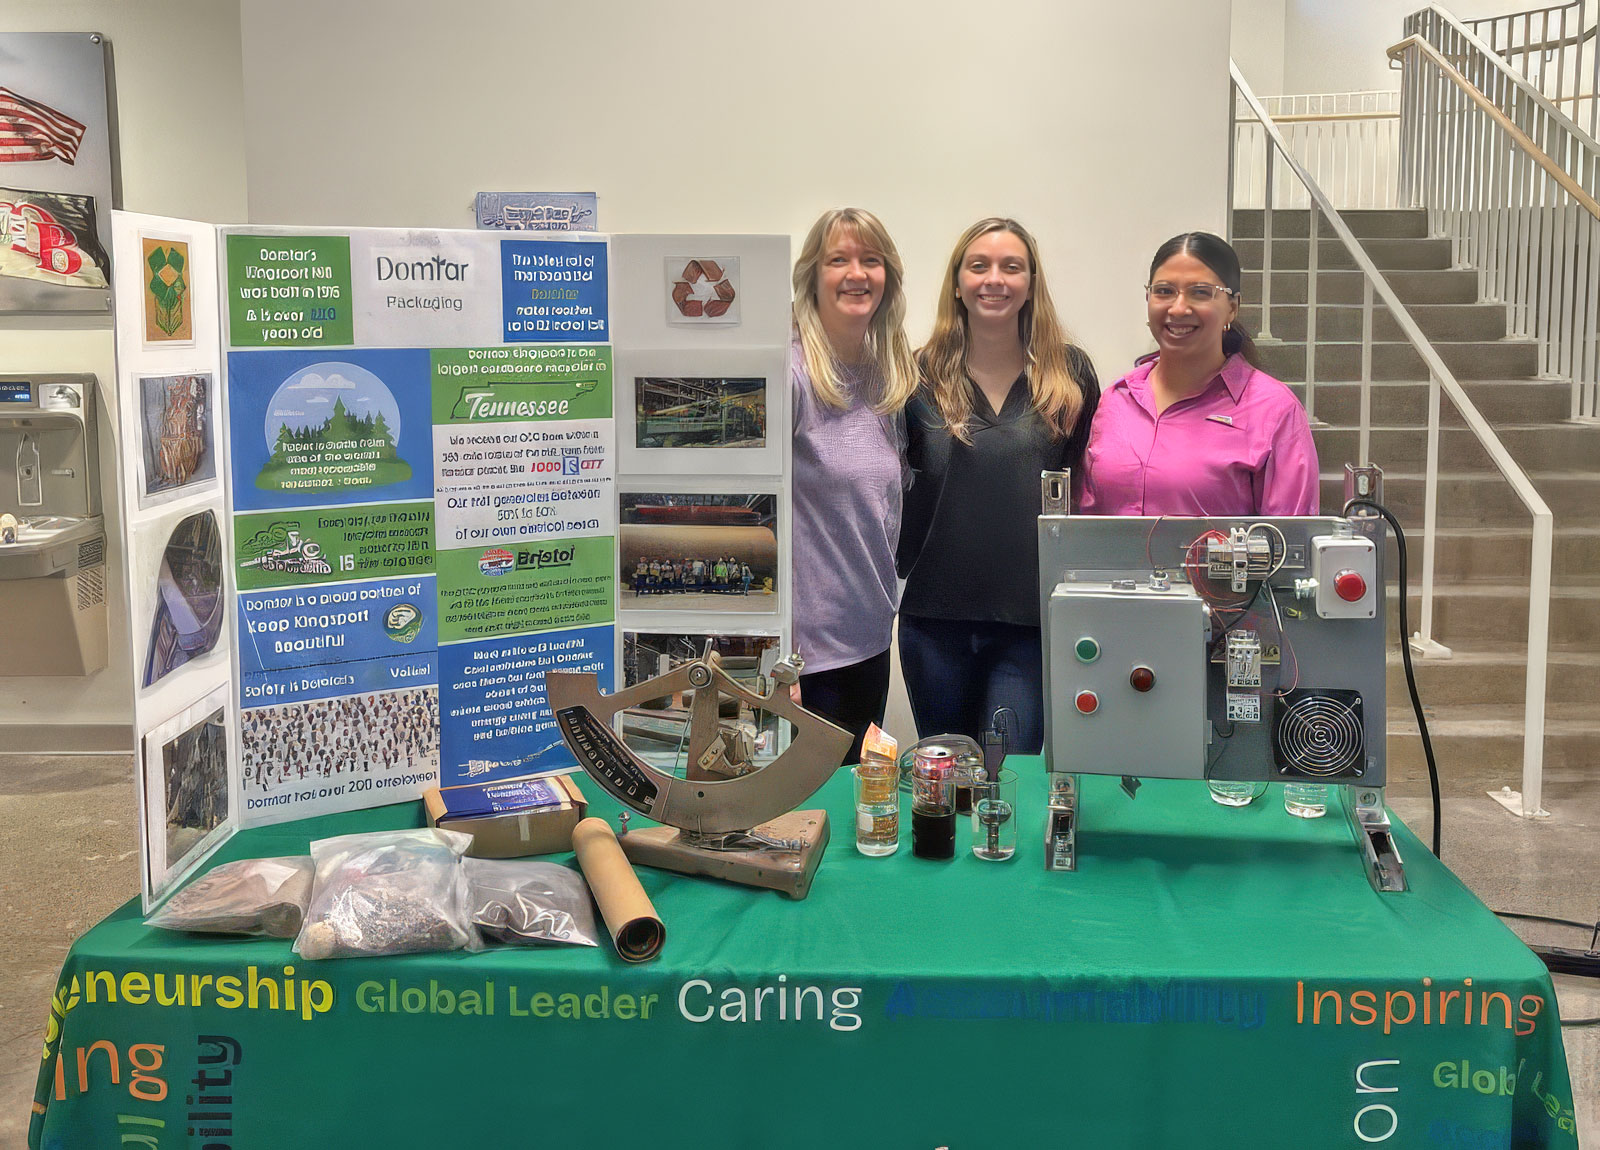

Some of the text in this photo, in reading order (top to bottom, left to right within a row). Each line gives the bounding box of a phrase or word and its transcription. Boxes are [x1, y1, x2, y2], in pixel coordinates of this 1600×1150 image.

[376, 254, 469, 281] Domtar
[387, 296, 463, 312] Packaging
[465, 393, 569, 420] Tennessee
[518, 545, 575, 565] Bristol
[348, 778, 372, 793] 200
[355, 979, 495, 1016] Global
[508, 985, 659, 1020] Leader
[677, 974, 863, 1032] Caring
[1296, 977, 1545, 1036] Inspiring
